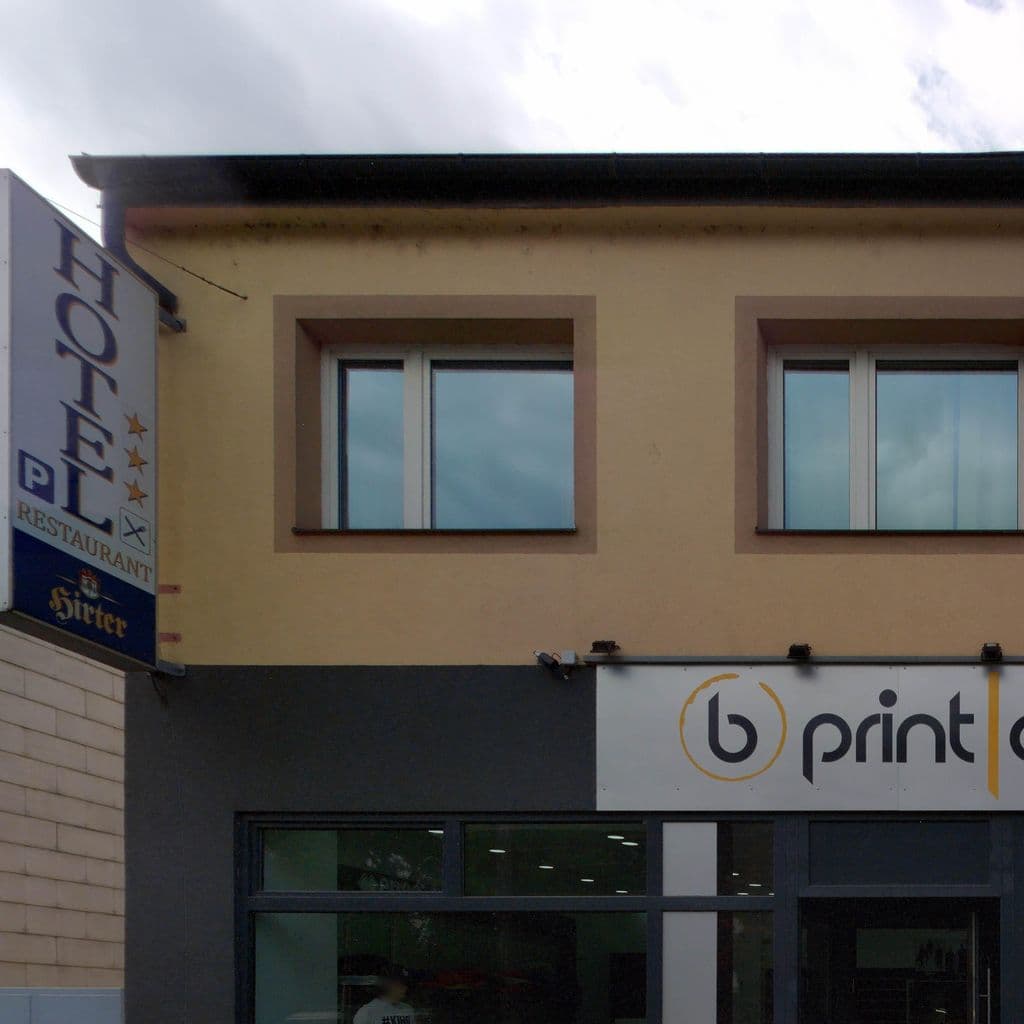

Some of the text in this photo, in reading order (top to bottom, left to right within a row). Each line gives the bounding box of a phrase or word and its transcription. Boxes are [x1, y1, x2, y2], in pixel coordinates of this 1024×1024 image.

[54, 218, 120, 537] HOTEL
[17, 500, 153, 583] RESTAURANT
[49, 587, 128, 638] Hirter
[708, 691, 758, 763] b
[803, 689, 975, 785] print
